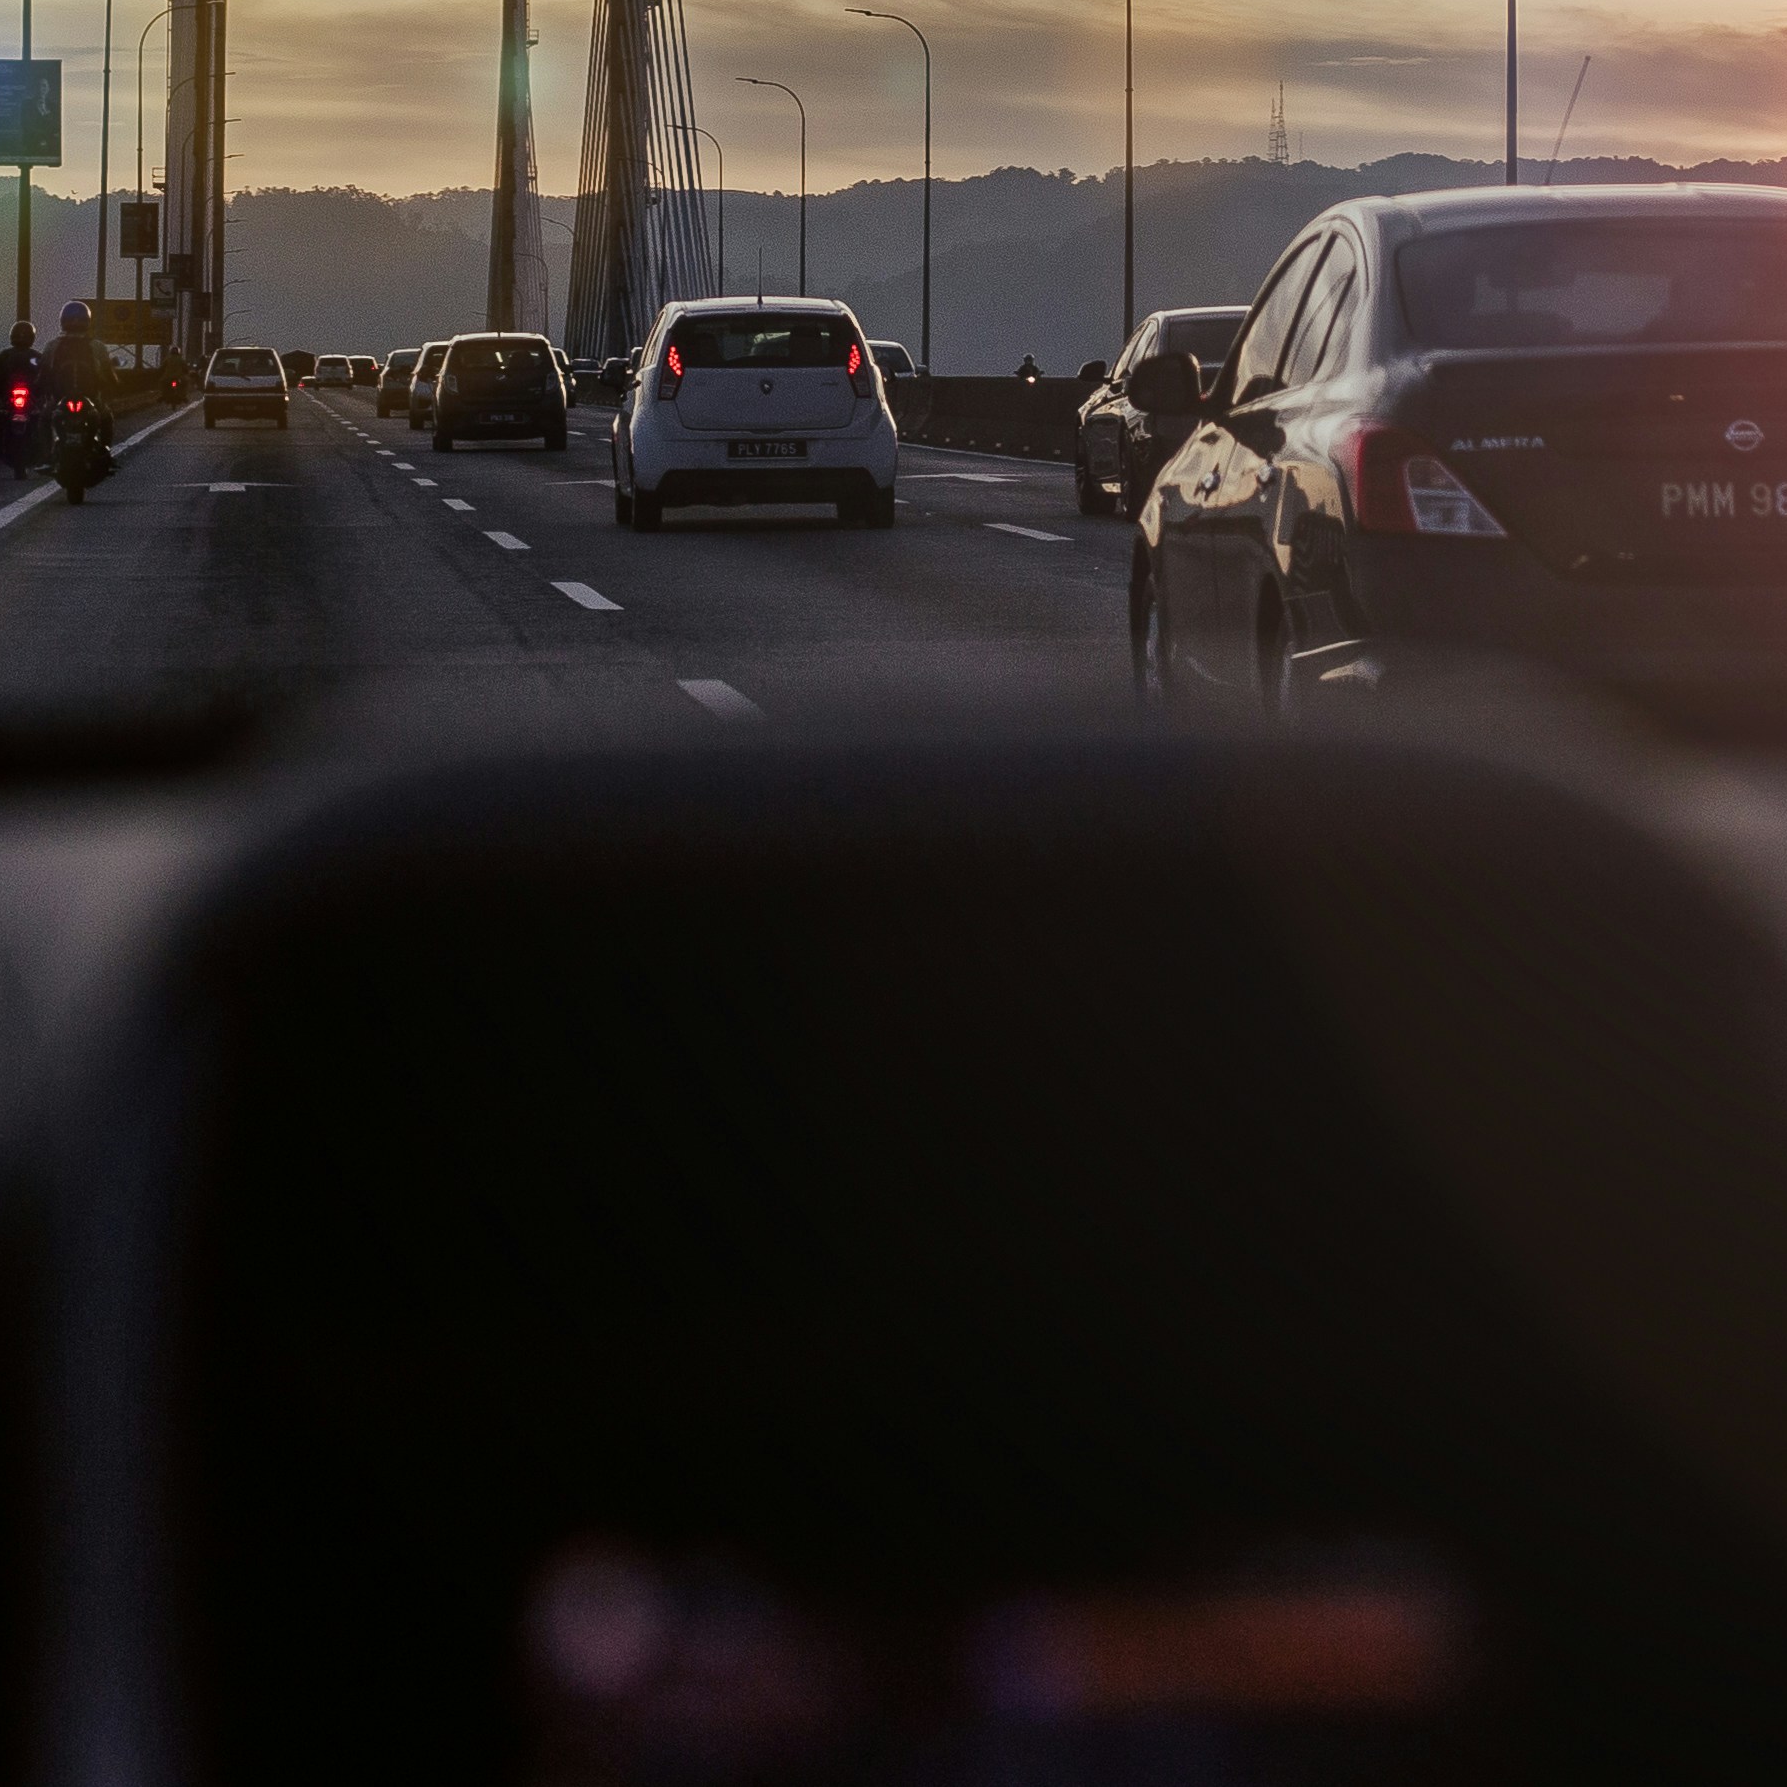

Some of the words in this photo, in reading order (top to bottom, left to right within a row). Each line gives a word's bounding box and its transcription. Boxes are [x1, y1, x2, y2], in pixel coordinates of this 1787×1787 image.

[738, 442, 761, 456] PLY
[766, 442, 797, 455] 7765
[1661, 481, 1736, 518] PMM
